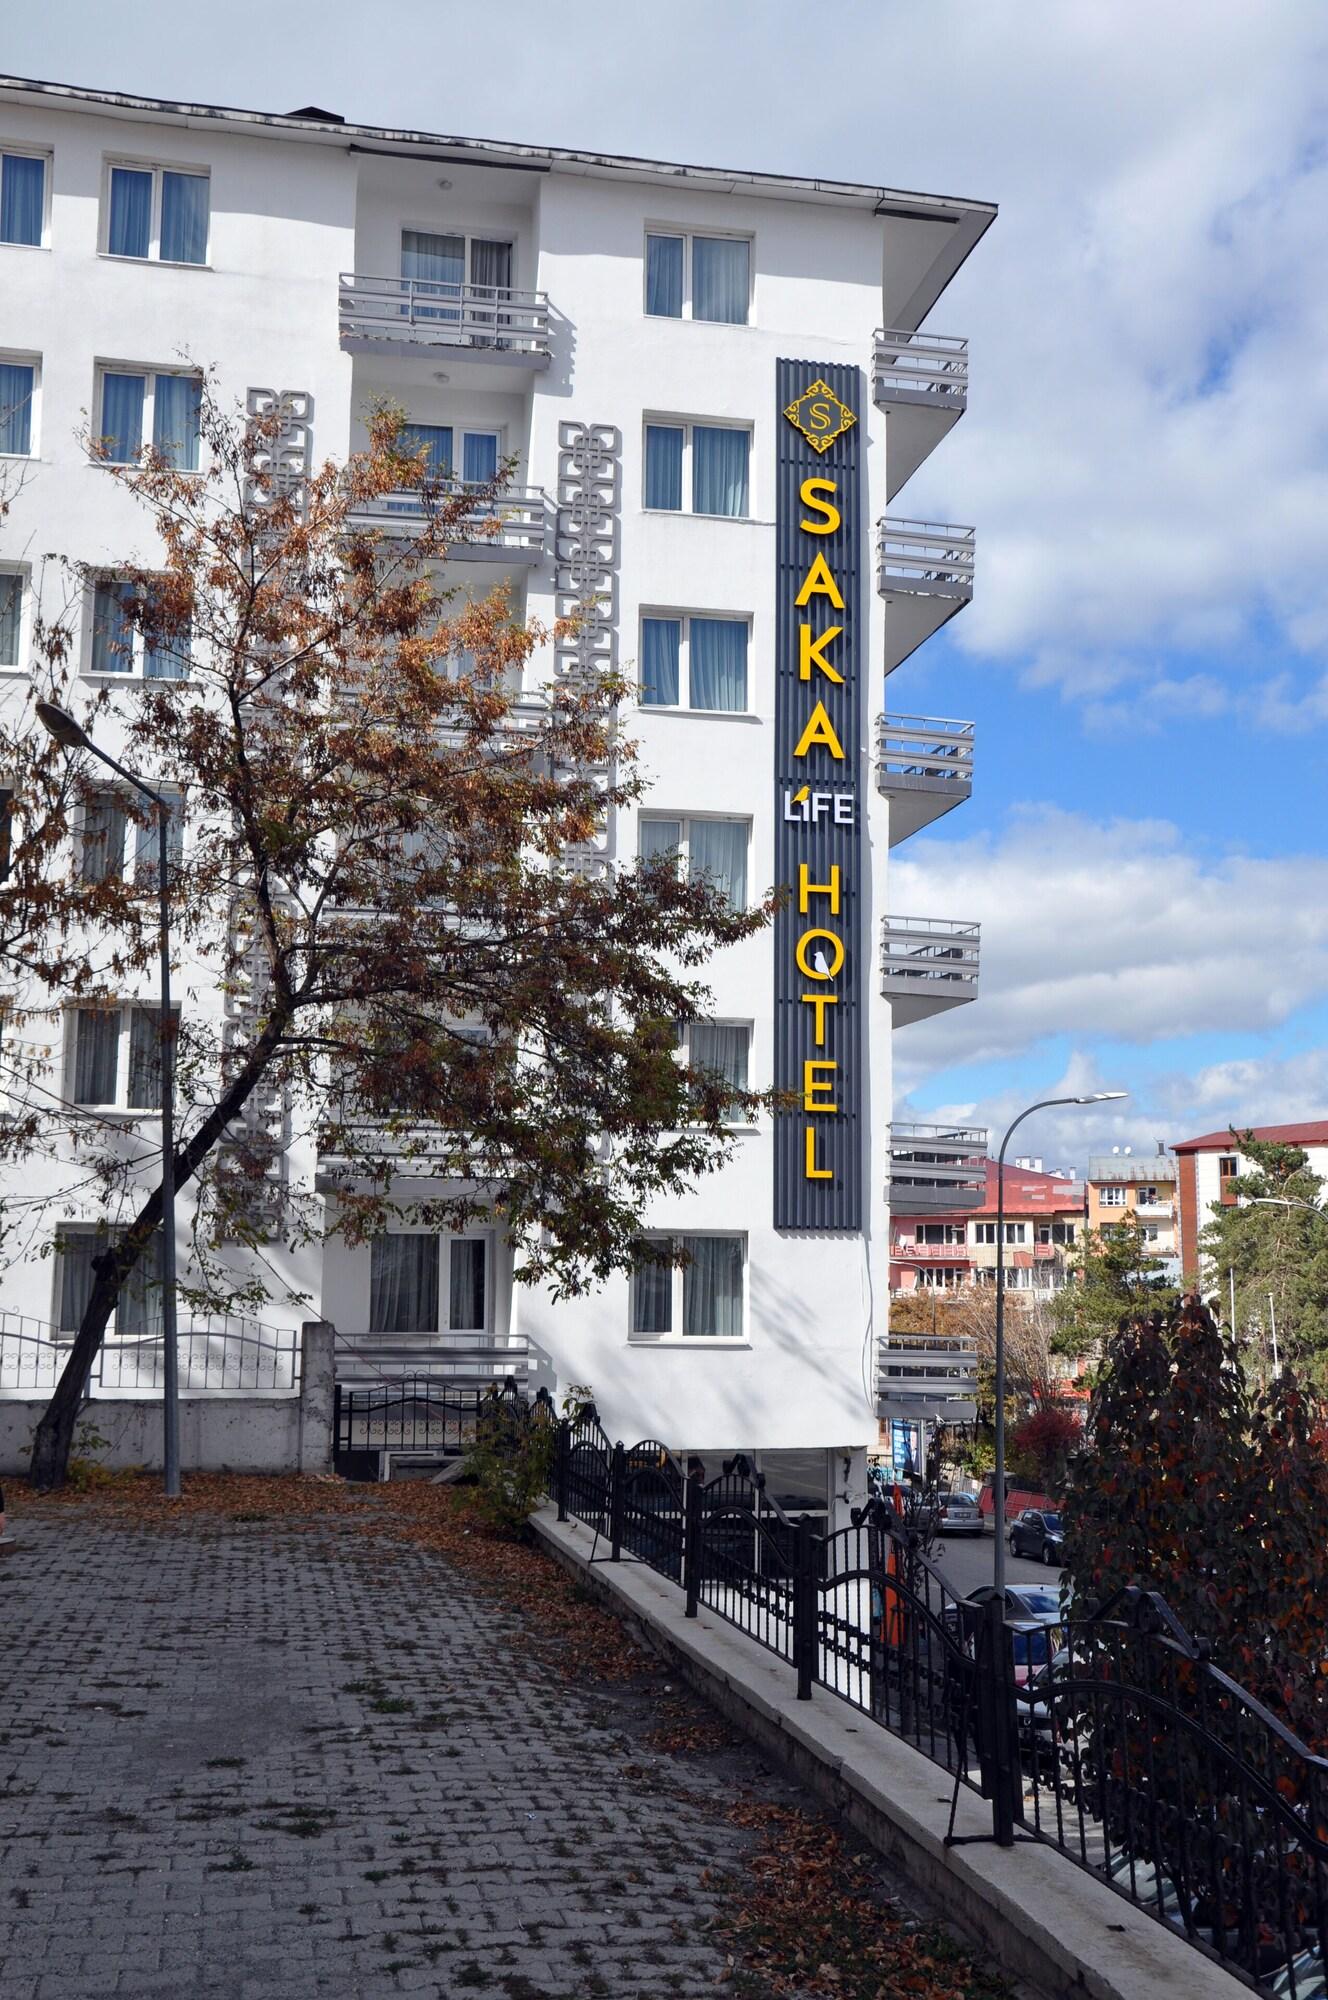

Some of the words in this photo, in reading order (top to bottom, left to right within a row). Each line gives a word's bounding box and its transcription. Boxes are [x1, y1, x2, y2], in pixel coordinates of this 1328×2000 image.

[794, 477, 845, 758] SAKA
[784, 788, 855, 825] LIFE
[795, 863, 845, 1179] HOTEL
